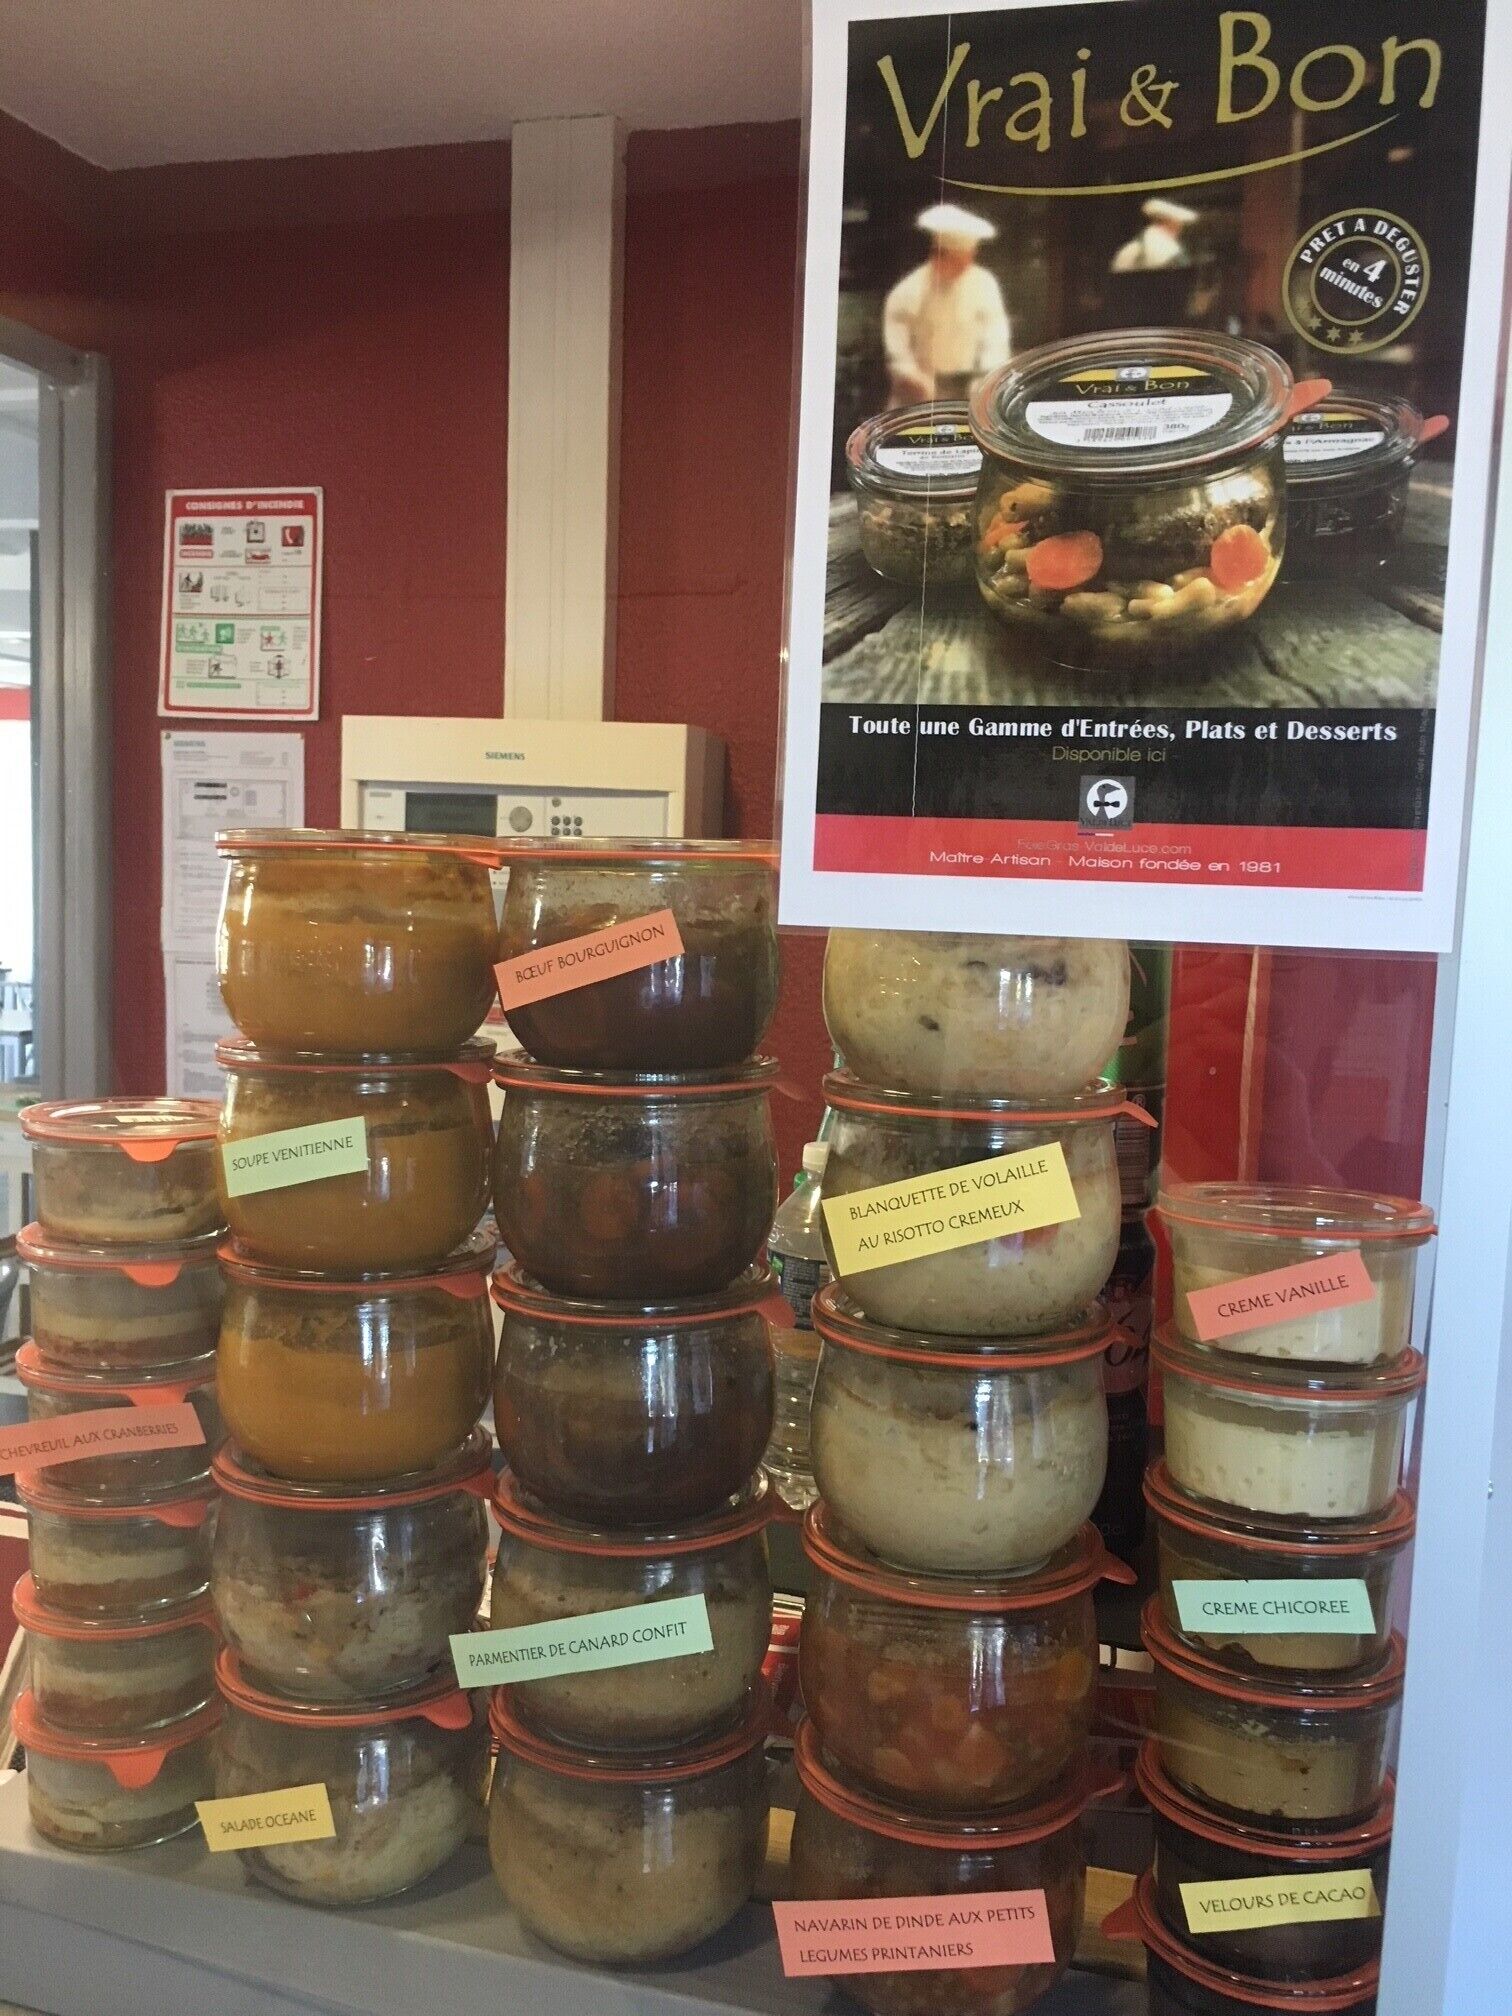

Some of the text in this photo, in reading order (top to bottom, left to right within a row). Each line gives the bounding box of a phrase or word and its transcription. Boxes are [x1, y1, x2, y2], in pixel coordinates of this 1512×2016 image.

[876, 11, 1443, 159] Vrai & Bon
[1300, 218, 1420, 315] PRET A DEGUSTER
[1342, 258, 1387, 283] en 4
[1319, 267, 1384, 308] minutes
[1075, 384, 1119, 395] Vrai
[1144, 380, 1190, 392] Bon
[849, 715, 1397, 742] Toute une Gamme d'Entrées, Plats et Desserts
[485, 751, 526, 761] SIEMENS
[1052, 746, 1167, 763] Disponible ici
[929, 851, 1281, 873] Maître Artisan Maison fondée en 1981
[558, 925, 665, 969] BOURGUIGNON
[232, 1136, 354, 1171] SOUPE VENITIENNE
[850, 1159, 1048, 1220] BLANQUETTE DE VOLAILLE
[858, 1200, 1025, 1251] AU RISOTTO CREMEUX
[1217, 1275, 1350, 1318] CREME VANILLE
[1, 1423, 179, 1460] CHEVREUIL AUX CRANBERRIES
[1202, 1600, 1350, 1616] CREME CHICOREE
[469, 1621, 688, 1667] PARMENTIER DE CANARD CONFIT
[220, 1809, 317, 1833] SALADE OCEANE
[1199, 1886, 1366, 1914] VELOURS DE CACAO
[794, 1906, 1035, 1932] NAVARIN DE DINDE AUX PETITS
[800, 1942, 974, 1964] LEGUMES PRINTANIERS
